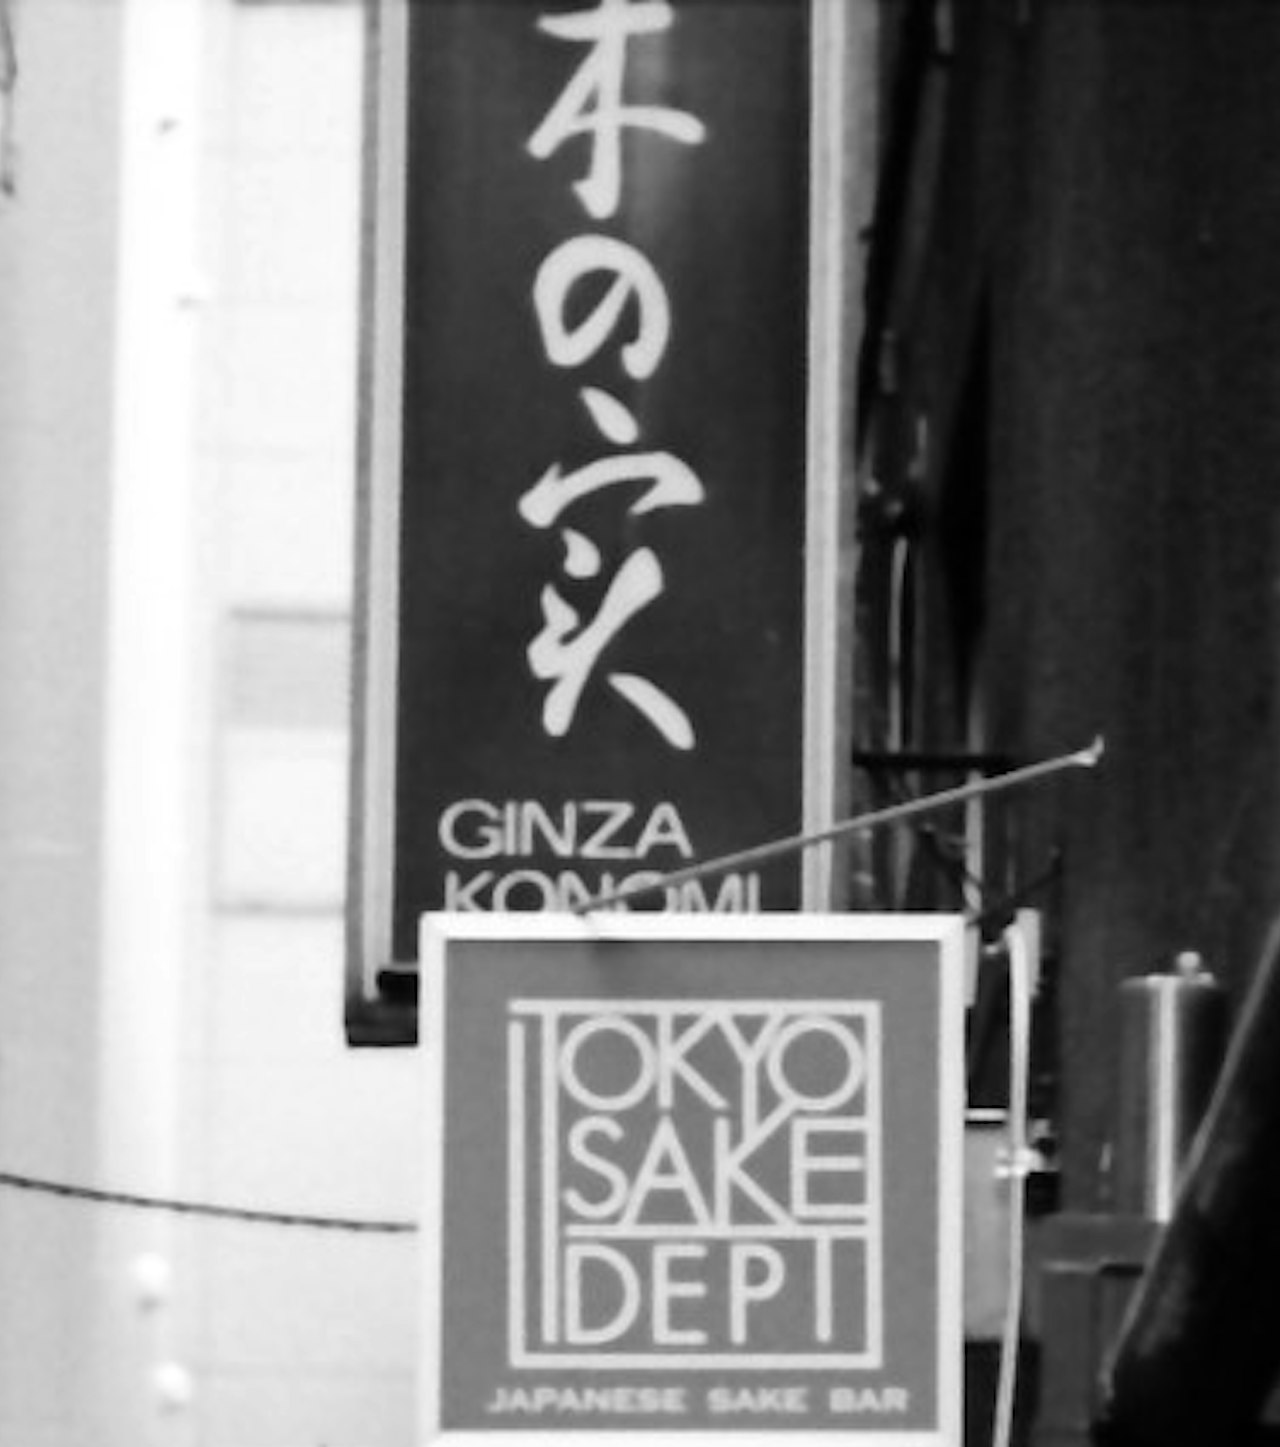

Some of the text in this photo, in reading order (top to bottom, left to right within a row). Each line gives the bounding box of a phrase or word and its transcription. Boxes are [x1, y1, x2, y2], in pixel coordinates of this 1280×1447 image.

[438, 799, 694, 860] GINZA
[564, 1114, 868, 1238] SAKE
[563, 1226, 868, 1346] DEPT
[487, 1386, 909, 1415] JAPANESE SAKE BAR
